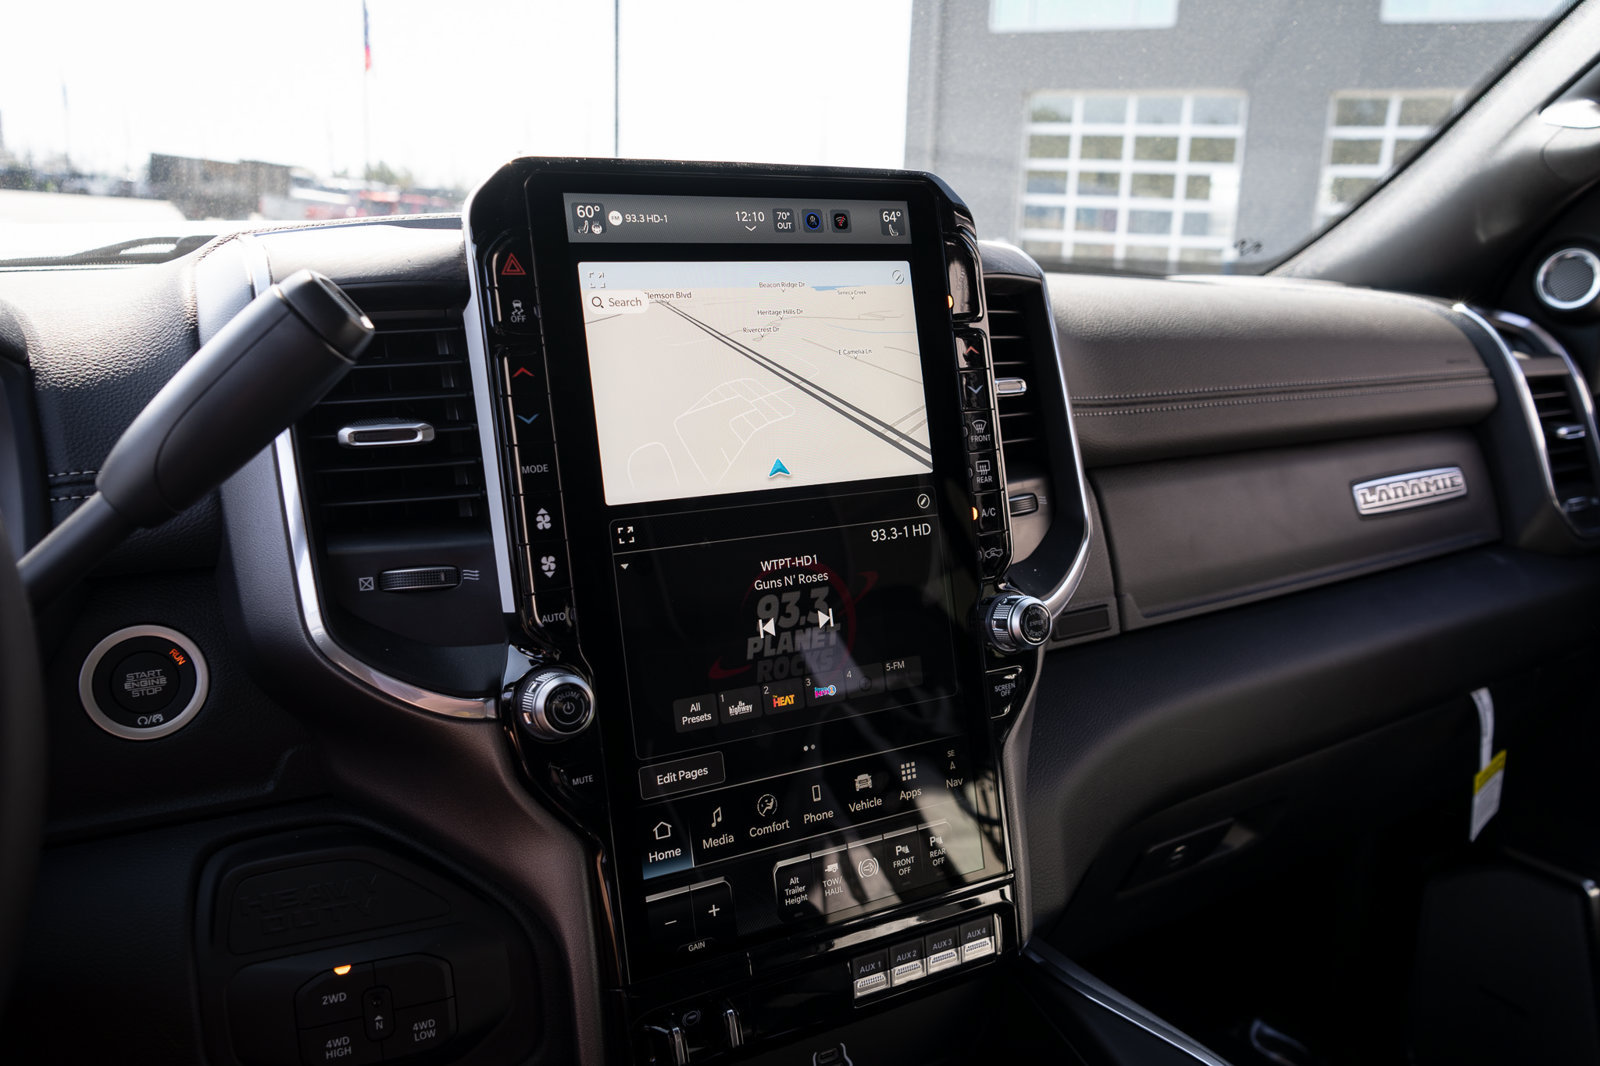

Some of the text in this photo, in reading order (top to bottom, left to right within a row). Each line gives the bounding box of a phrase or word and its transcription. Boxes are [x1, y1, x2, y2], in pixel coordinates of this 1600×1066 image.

[577, 205, 600, 218] 60°
[735, 211, 765, 222] 12:10
[776, 211, 790, 220] 70°
[882, 211, 901, 223] 64°
[625, 214, 668, 223] 93.3 HD-1
[777, 222, 792, 230] OUT
[781, 281, 796, 289] Ridge
[675, 291, 692, 299] Blvd
[608, 297, 642, 307] Search
[757, 309, 782, 317] Heritage
[510, 315, 526, 323] OFF
[970, 434, 991, 442] FRONT
[521, 463, 549, 474] MODE
[976, 476, 993, 484] REAR
[1360, 475, 1461, 505] LARAMIE
[981, 507, 996, 517] A/C
[871, 523, 931, 542] 93.3-1 HD
[760, 554, 818, 572] WTPT-HD1
[754, 572, 829, 591] Guns N' Roses
[542, 612, 566, 623] AUTO
[746, 623, 841, 660] PLANET
[169, 648, 187, 666] RUN
[757, 648, 835, 682] ROCKS
[885, 661, 905, 672] 5-FM
[126, 669, 163, 681] START
[846, 670, 852, 678] 4
[124, 677, 168, 690] ENGINE
[805, 678, 811, 687] 3
[994, 682, 1016, 692] SCREEN
[131, 687, 163, 698] STOP
[763, 686, 770, 694] 2
[720, 694, 725, 702] 1
[772, 694, 795, 708] HEAT
[690, 702, 701, 713] All
[728, 704, 753, 716] highway
[681, 712, 712, 725] Presets
[572, 774, 593, 786] MUTE
[656, 767, 709, 785] Edit Pages
[946, 777, 964, 789] Nav
[899, 787, 922, 801] Apps
[848, 797, 883, 813] Vehicle
[803, 809, 834, 824] Phone
[749, 819, 790, 838] Comfort
[702, 833, 734, 849] Media
[648, 847, 682, 863] Home
[929, 848, 946, 858] REAR
[893, 856, 915, 868] FRONT
[932, 857, 945, 867] OFF
[898, 867, 911, 876] OFF
[789, 877, 799, 886] Alt
[823, 876, 843, 888] TOW/
[784, 885, 806, 896] Trailer
[825, 887, 844, 897] HAUL
[785, 893, 808, 906] Height
[966, 929, 981, 939] AUX
[688, 941, 705, 952] GAIN
[932, 941, 947, 951] AUX
[896, 952, 912, 962] AUX
[859, 964, 876, 974] AUX
[322, 992, 347, 1006] 2WD
[375, 1020, 384, 1030] N
[412, 1019, 436, 1032] 4WD
[414, 1029, 437, 1042] LOW
[326, 1036, 350, 1049] 4WD
[325, 1047, 352, 1060] HIGH
